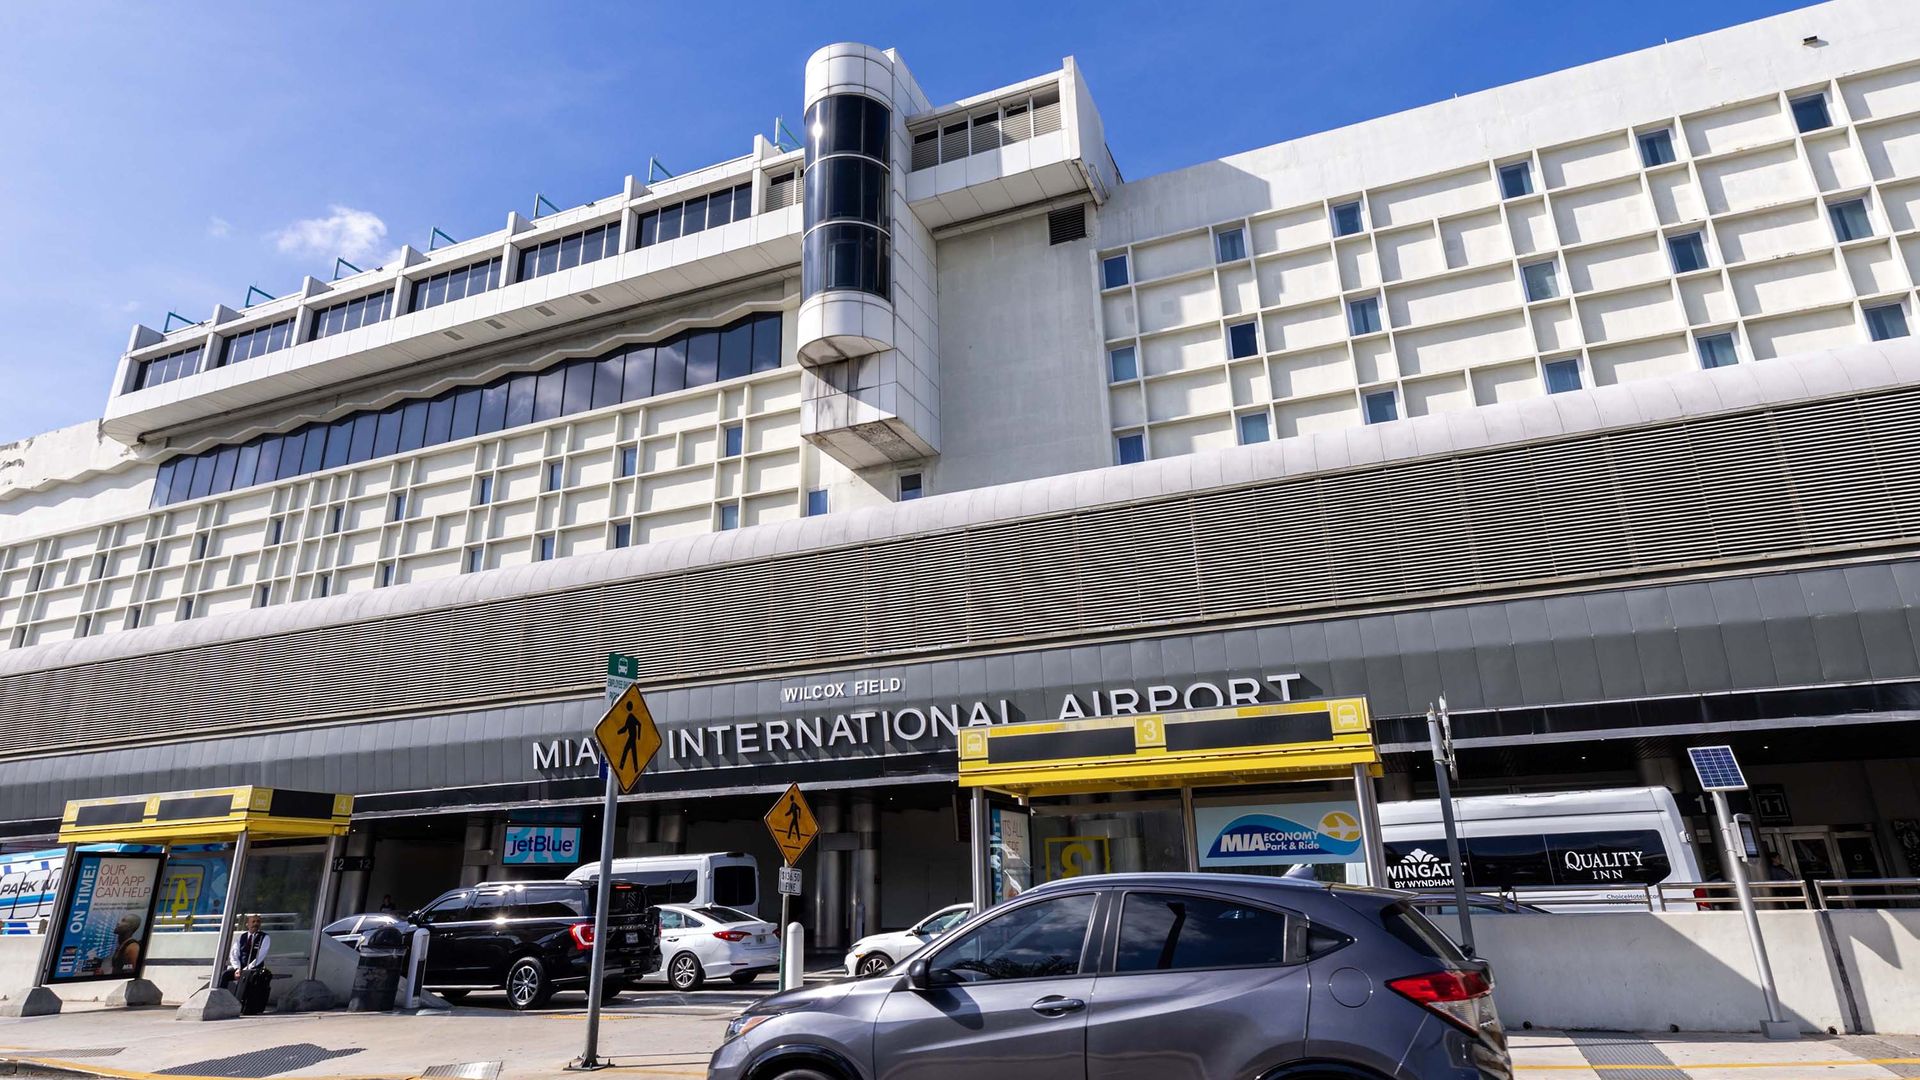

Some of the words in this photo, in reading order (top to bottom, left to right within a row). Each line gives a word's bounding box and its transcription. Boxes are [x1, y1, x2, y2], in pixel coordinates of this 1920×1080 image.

[783, 682, 845, 701] WILCOX
[854, 677, 901, 696] FIELD
[532, 737, 600, 770] MIA
[668, 699, 1010, 759] INTERNATIONAL
[1059, 672, 1302, 720] AIRPORT
[1142, 719, 1157, 741] 3
[1761, 798, 1784, 813] 11
[510, 835, 573, 856] jetBlue
[1220, 833, 1266, 852] MIA
[1264, 831, 1319, 842] ECONOMY
[1265, 842, 1287, 851] Park
[1289, 841, 1297, 850] &
[1299, 841, 1320, 850] Ride
[333, 857, 345, 871] 12
[1564, 850, 1643, 871] QUALITY
[100, 864, 128, 876] OUR
[1386, 863, 1464, 880] WINGAT
[1592, 869, 1623, 880] INN
[0, 880, 38, 895] PARK
[76, 865, 97, 907] TIME!
[97, 876, 120, 887] MIA
[121, 875, 146, 887] APP
[1394, 881, 1406, 889] BY
[1407, 879, 1455, 888] WYNDHAM
[95, 887, 121, 898] CAN
[122, 887, 151, 898] HELP
[70, 911, 86, 934] ON
